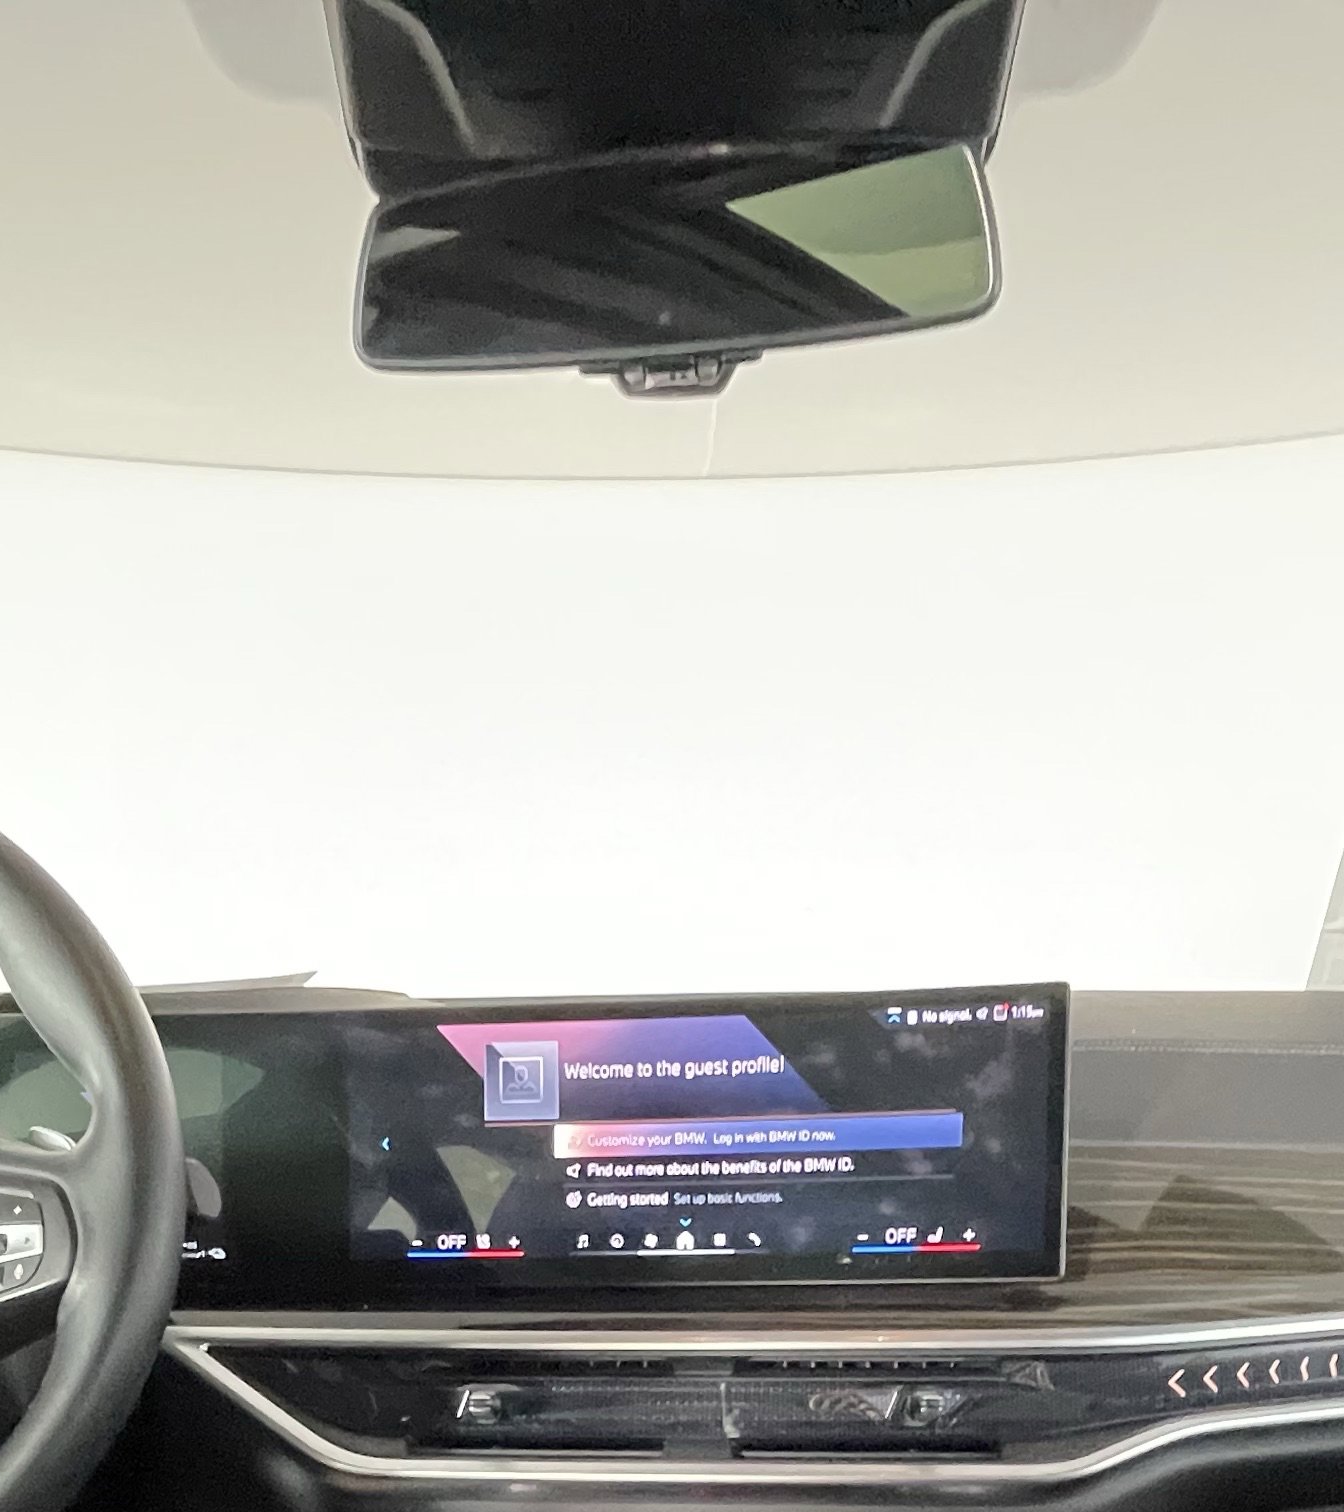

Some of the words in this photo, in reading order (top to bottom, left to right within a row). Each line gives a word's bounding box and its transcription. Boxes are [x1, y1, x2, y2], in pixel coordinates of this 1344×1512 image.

[922, 1010, 937, 1023] No
[564, 1062, 633, 1079] Welcome
[637, 1062, 653, 1078] to
[656, 1060, 681, 1077] the
[684, 1059, 728, 1079] guest
[587, 1135, 645, 1147] Customize
[647, 1136, 673, 1147] your
[713, 1133, 732, 1145] Log
[734, 1133, 744, 1144] in
[746, 1132, 767, 1144] with
[769, 1131, 797, 1143] BMW
[798, 1130, 809, 1142] ID
[587, 1163, 612, 1178] Find
[614, 1164, 633, 1177] out
[635, 1165, 664, 1177] more
[667, 1161, 699, 1176] about
[701, 1160, 719, 1175] the
[722, 1160, 767, 1175] benefits
[769, 1158, 781, 1173] of
[782, 1159, 802, 1173] the
[804, 1157, 836, 1173] BMW
[587, 1192, 628, 1209] Getting
[630, 1191, 669, 1207] started
[673, 1192, 691, 1206] Set
[692, 1194, 706, 1206] up
[708, 1191, 733, 1205] basic
[437, 1234, 467, 1250] OFF
[885, 1227, 917, 1244] OFF
